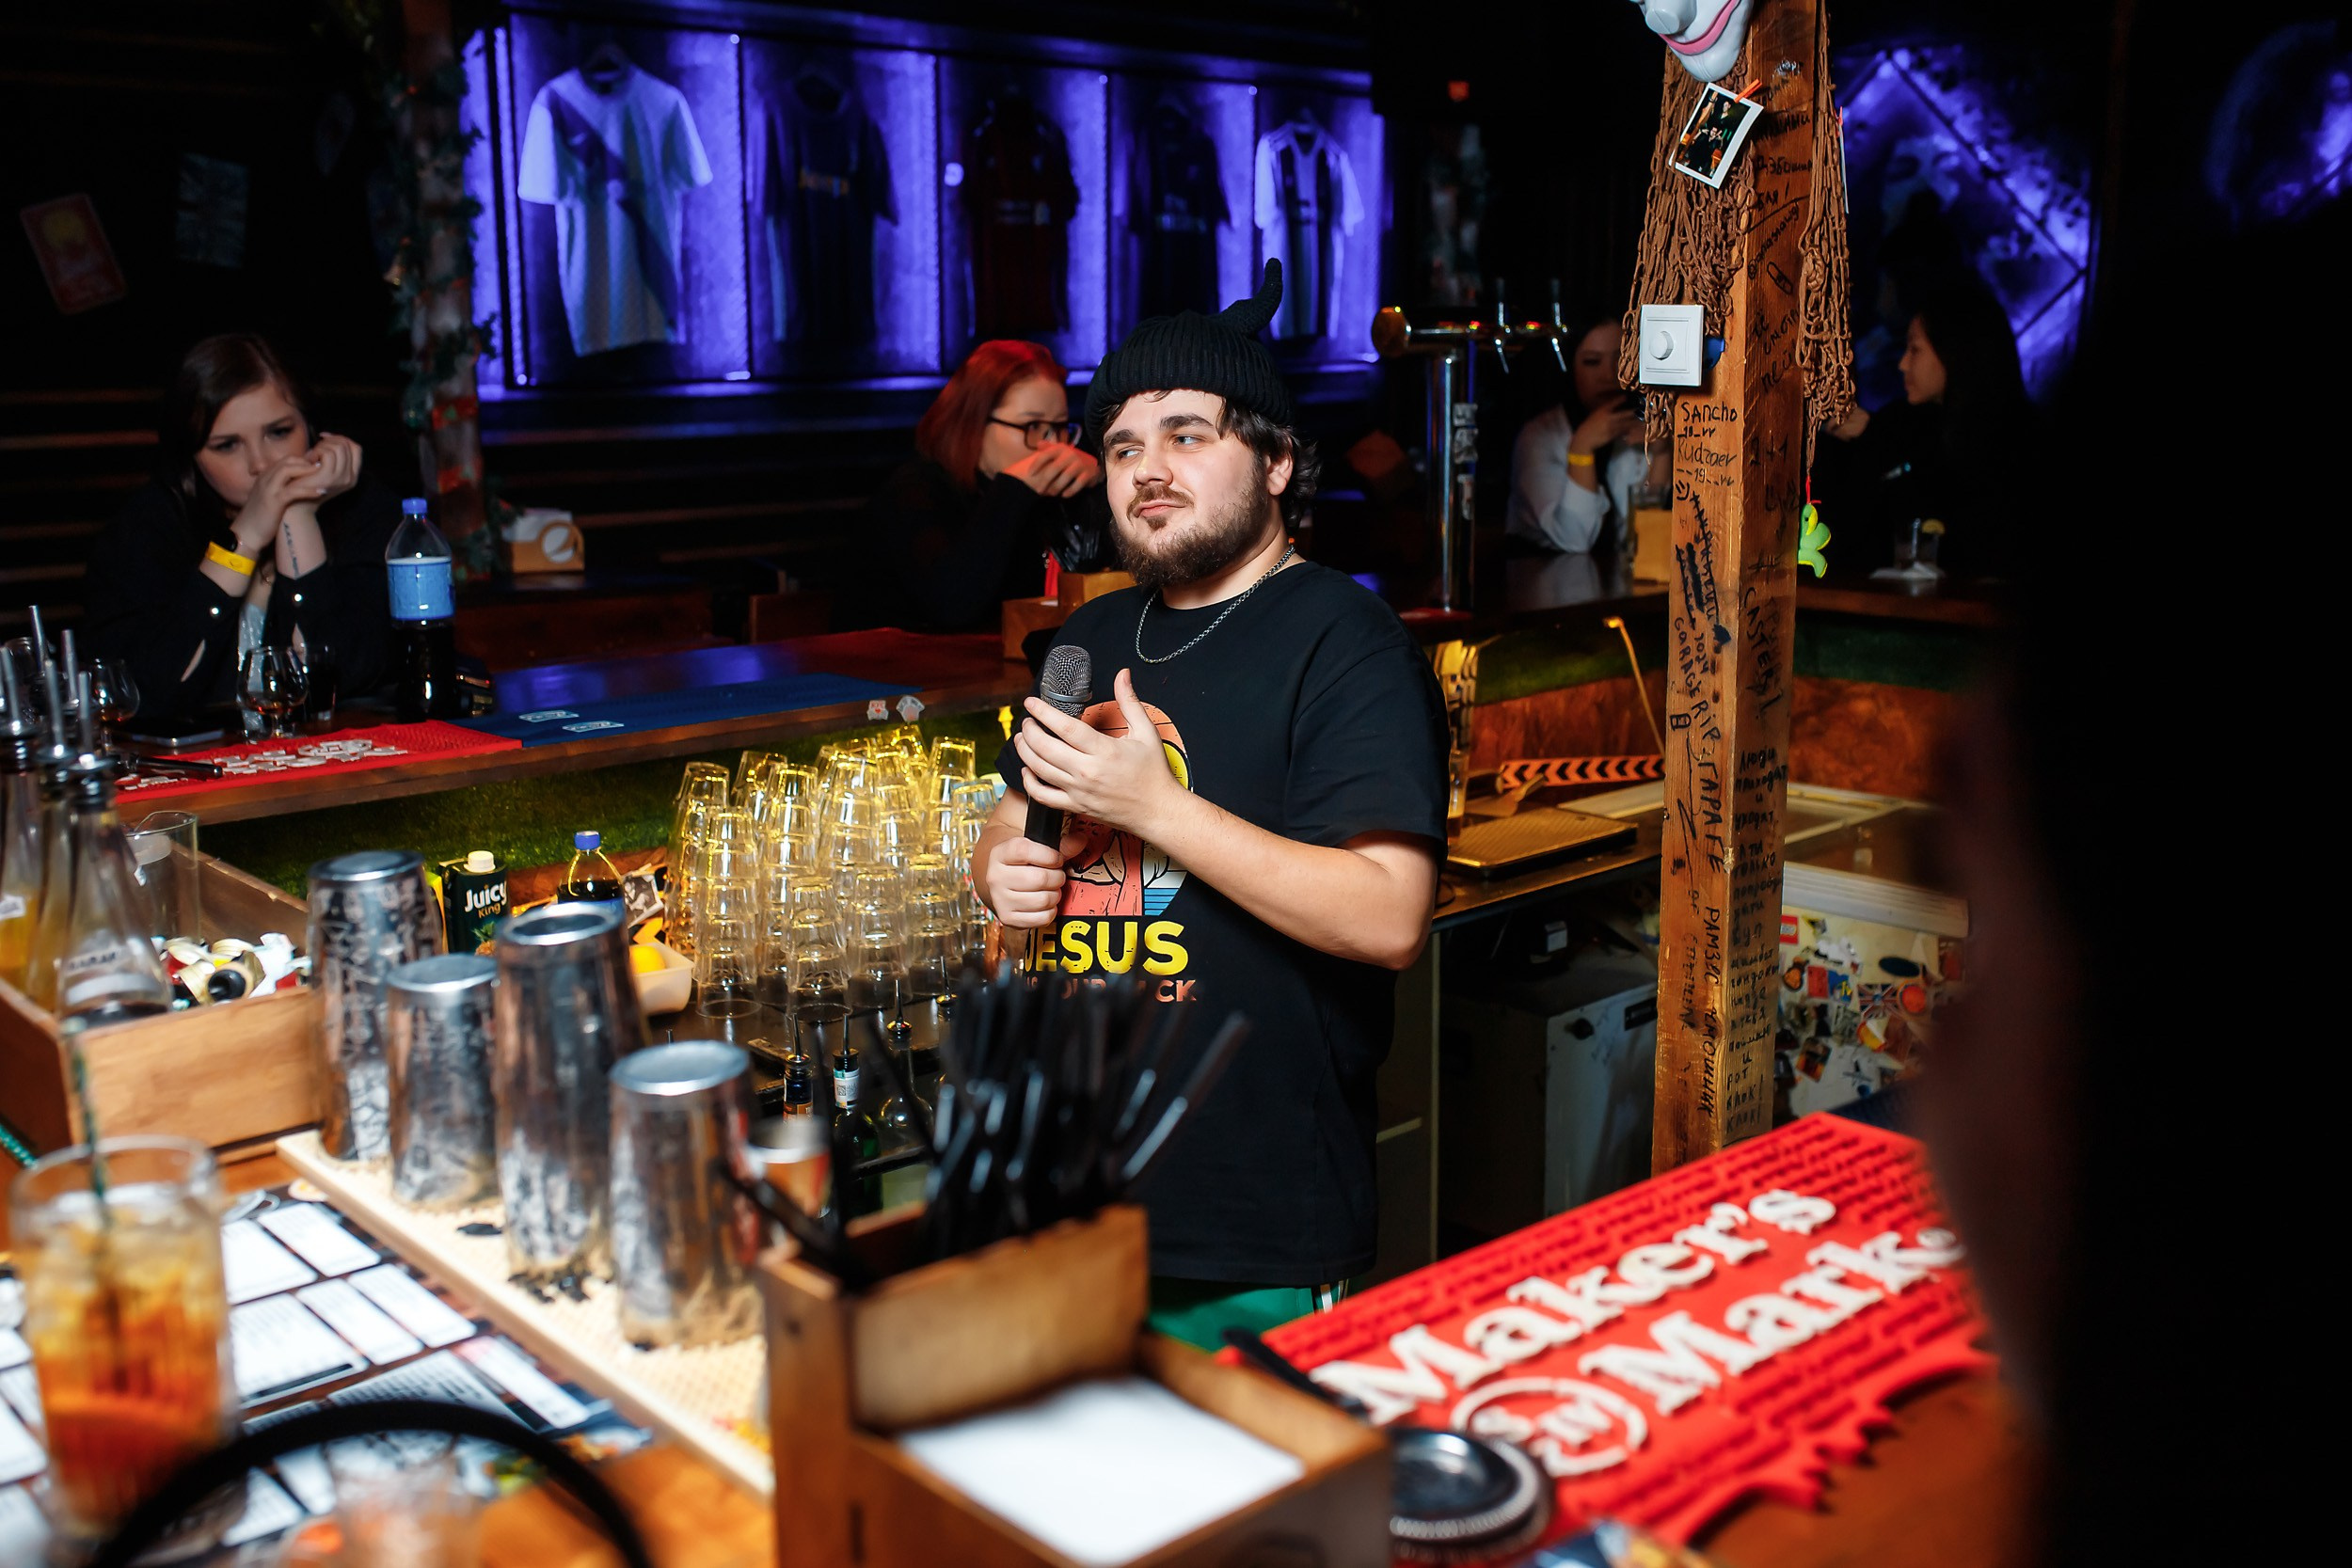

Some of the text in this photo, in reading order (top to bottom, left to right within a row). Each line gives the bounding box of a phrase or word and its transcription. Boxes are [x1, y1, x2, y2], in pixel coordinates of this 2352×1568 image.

[464, 880, 508, 912] Juicy
[478, 903, 501, 919] King
[1024, 920, 1190, 976] JESUS
[1309, 1189, 1836, 1427] Maker's
